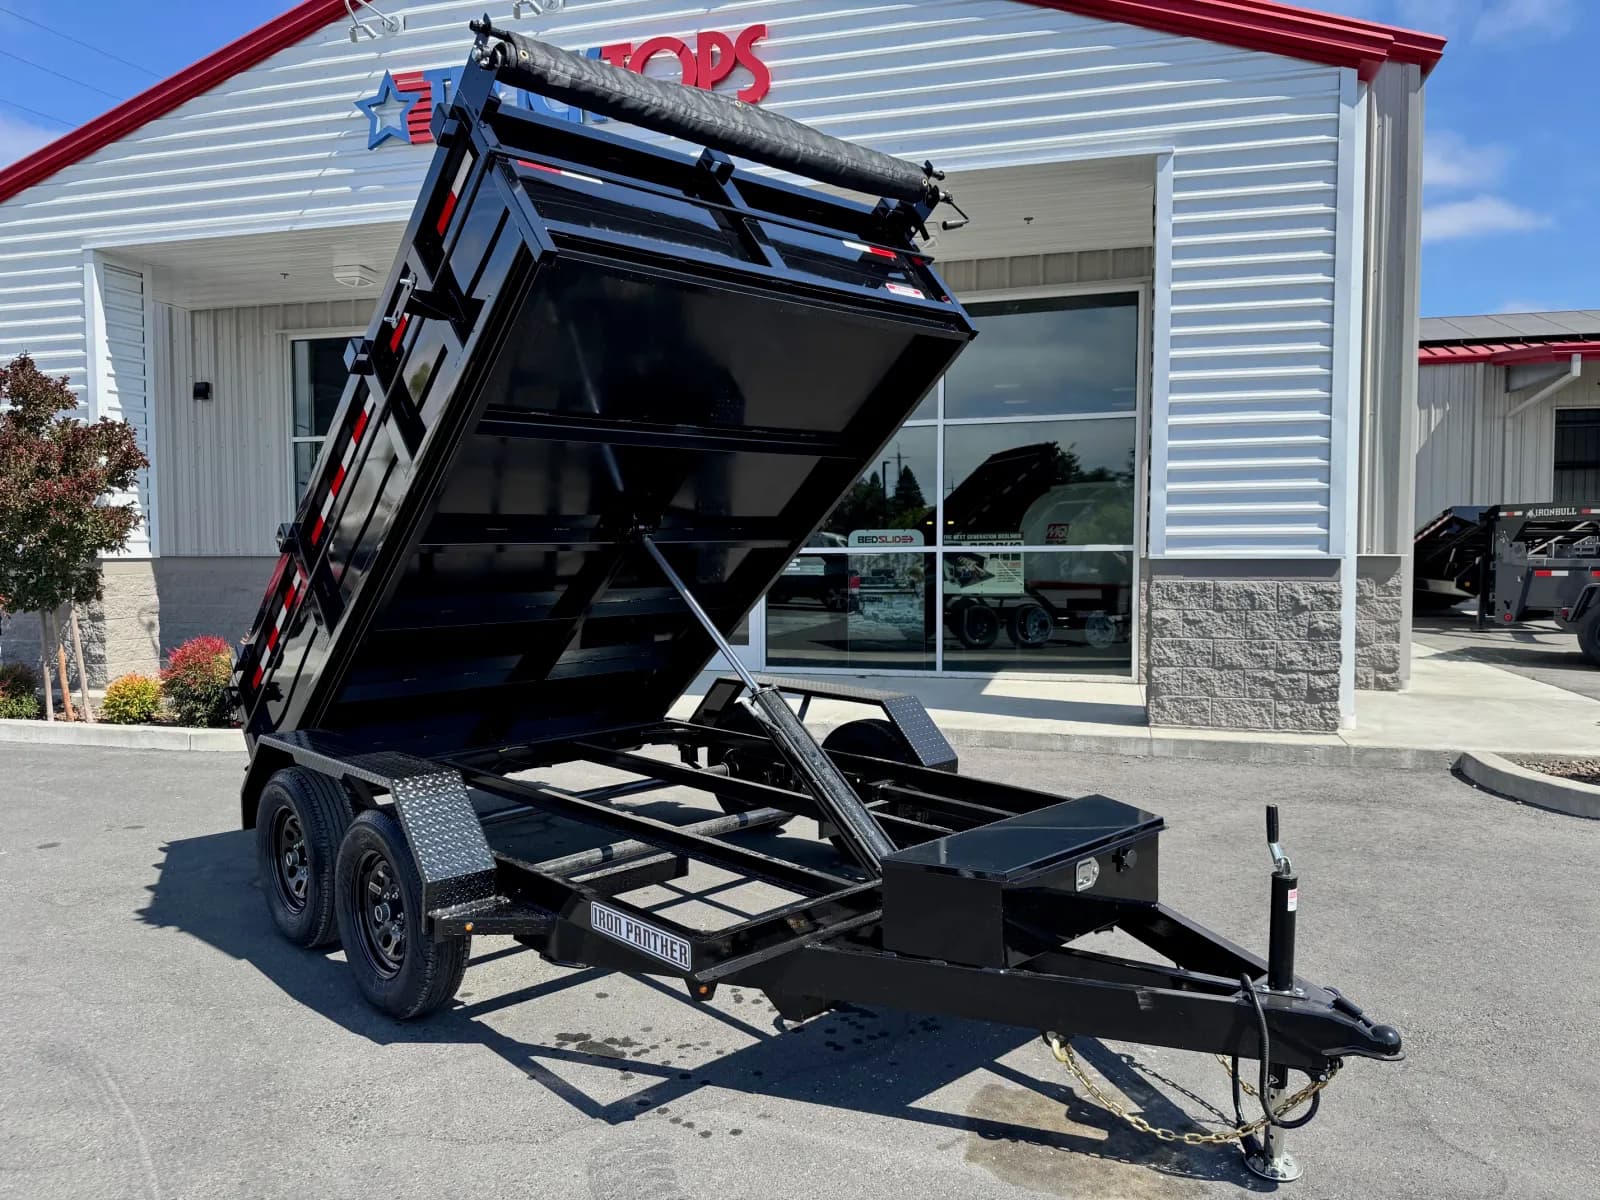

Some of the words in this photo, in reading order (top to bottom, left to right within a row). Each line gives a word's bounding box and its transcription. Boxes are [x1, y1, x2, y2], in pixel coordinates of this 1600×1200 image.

[1535, 507, 1577, 517] IRONBULL
[857, 535, 914, 544] BEDSLIDE
[593, 907, 623, 936] IRON
[625, 921, 689, 967] PANTHER
